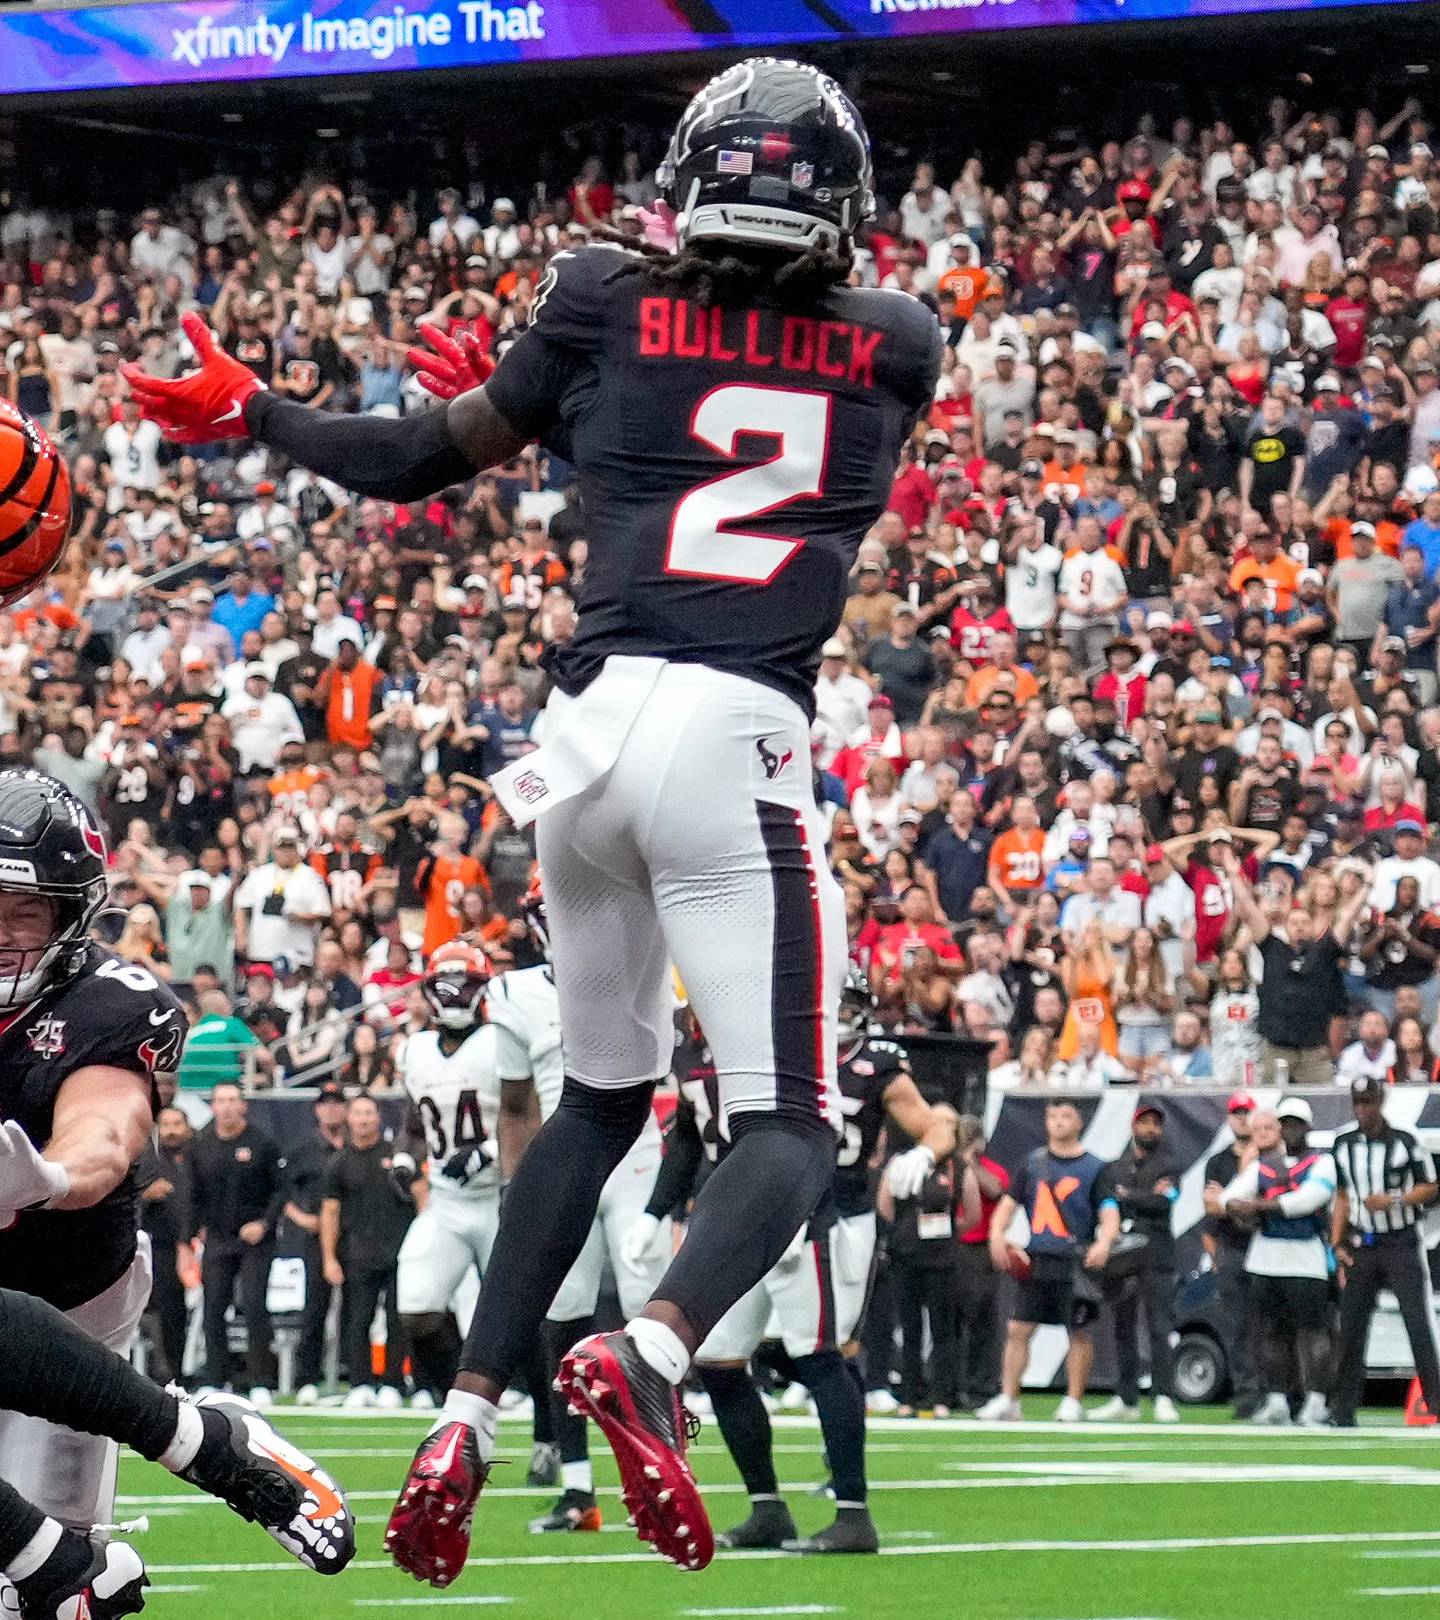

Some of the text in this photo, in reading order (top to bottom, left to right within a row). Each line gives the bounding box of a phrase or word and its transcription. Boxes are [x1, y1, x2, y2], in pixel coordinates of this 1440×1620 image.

[171, 1, 546, 66] xfinity Imagine That
[733, 213, 803, 231] HOUSTON
[639, 297, 885, 390] BULLOCK
[664, 381, 832, 587] 2
[418, 1088, 486, 1161] 34
